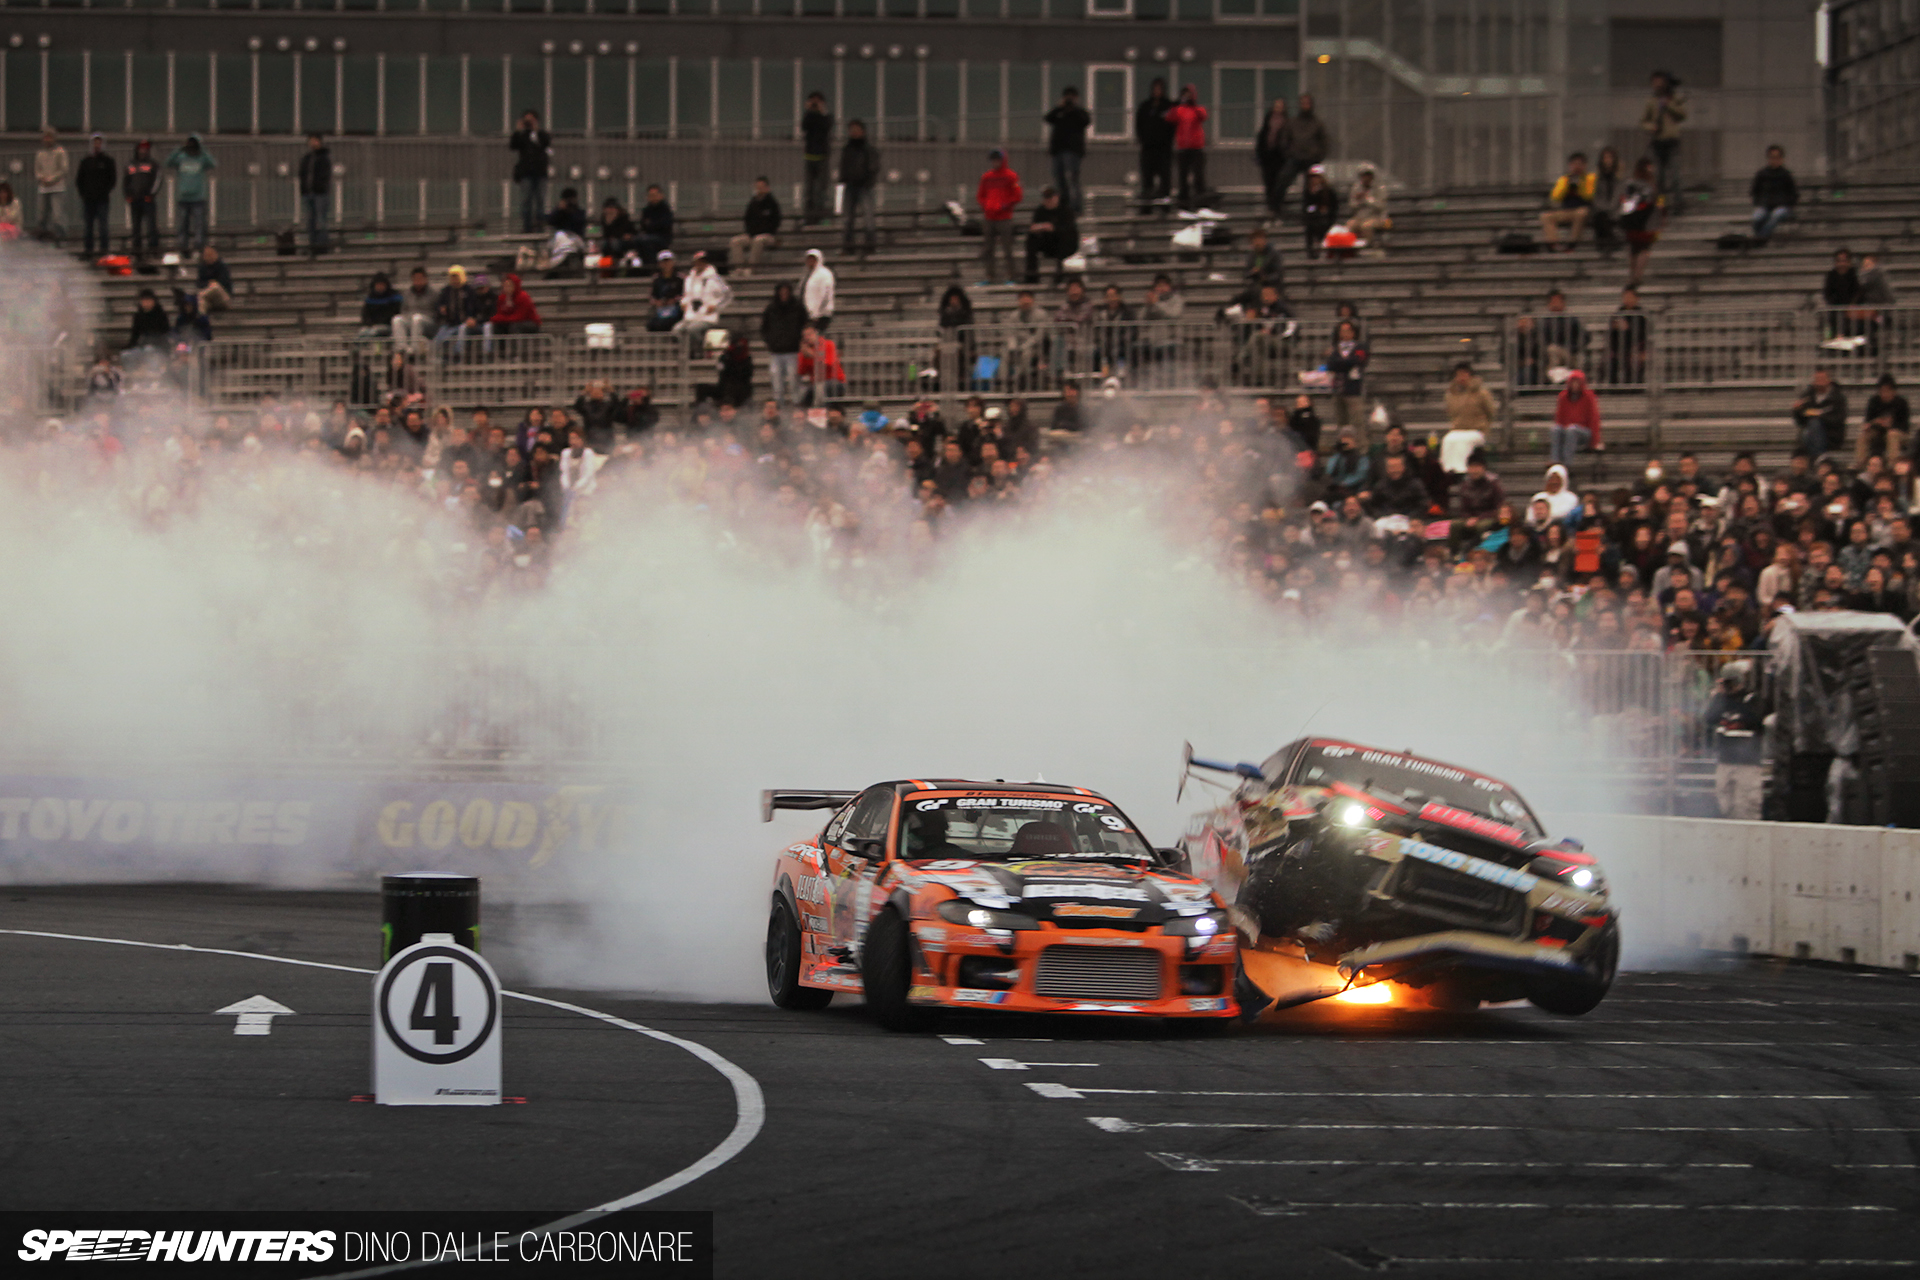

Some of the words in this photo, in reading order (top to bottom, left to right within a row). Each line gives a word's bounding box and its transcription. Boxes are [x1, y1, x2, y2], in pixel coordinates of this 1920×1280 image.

[956, 798, 998, 807] GRAN
[1000, 799, 1064, 808] TURISMO
[0, 797, 147, 845] TOYO
[150, 799, 313, 846] TIRES
[1100, 815, 1127, 831] 9
[409, 963, 460, 1045] 4
